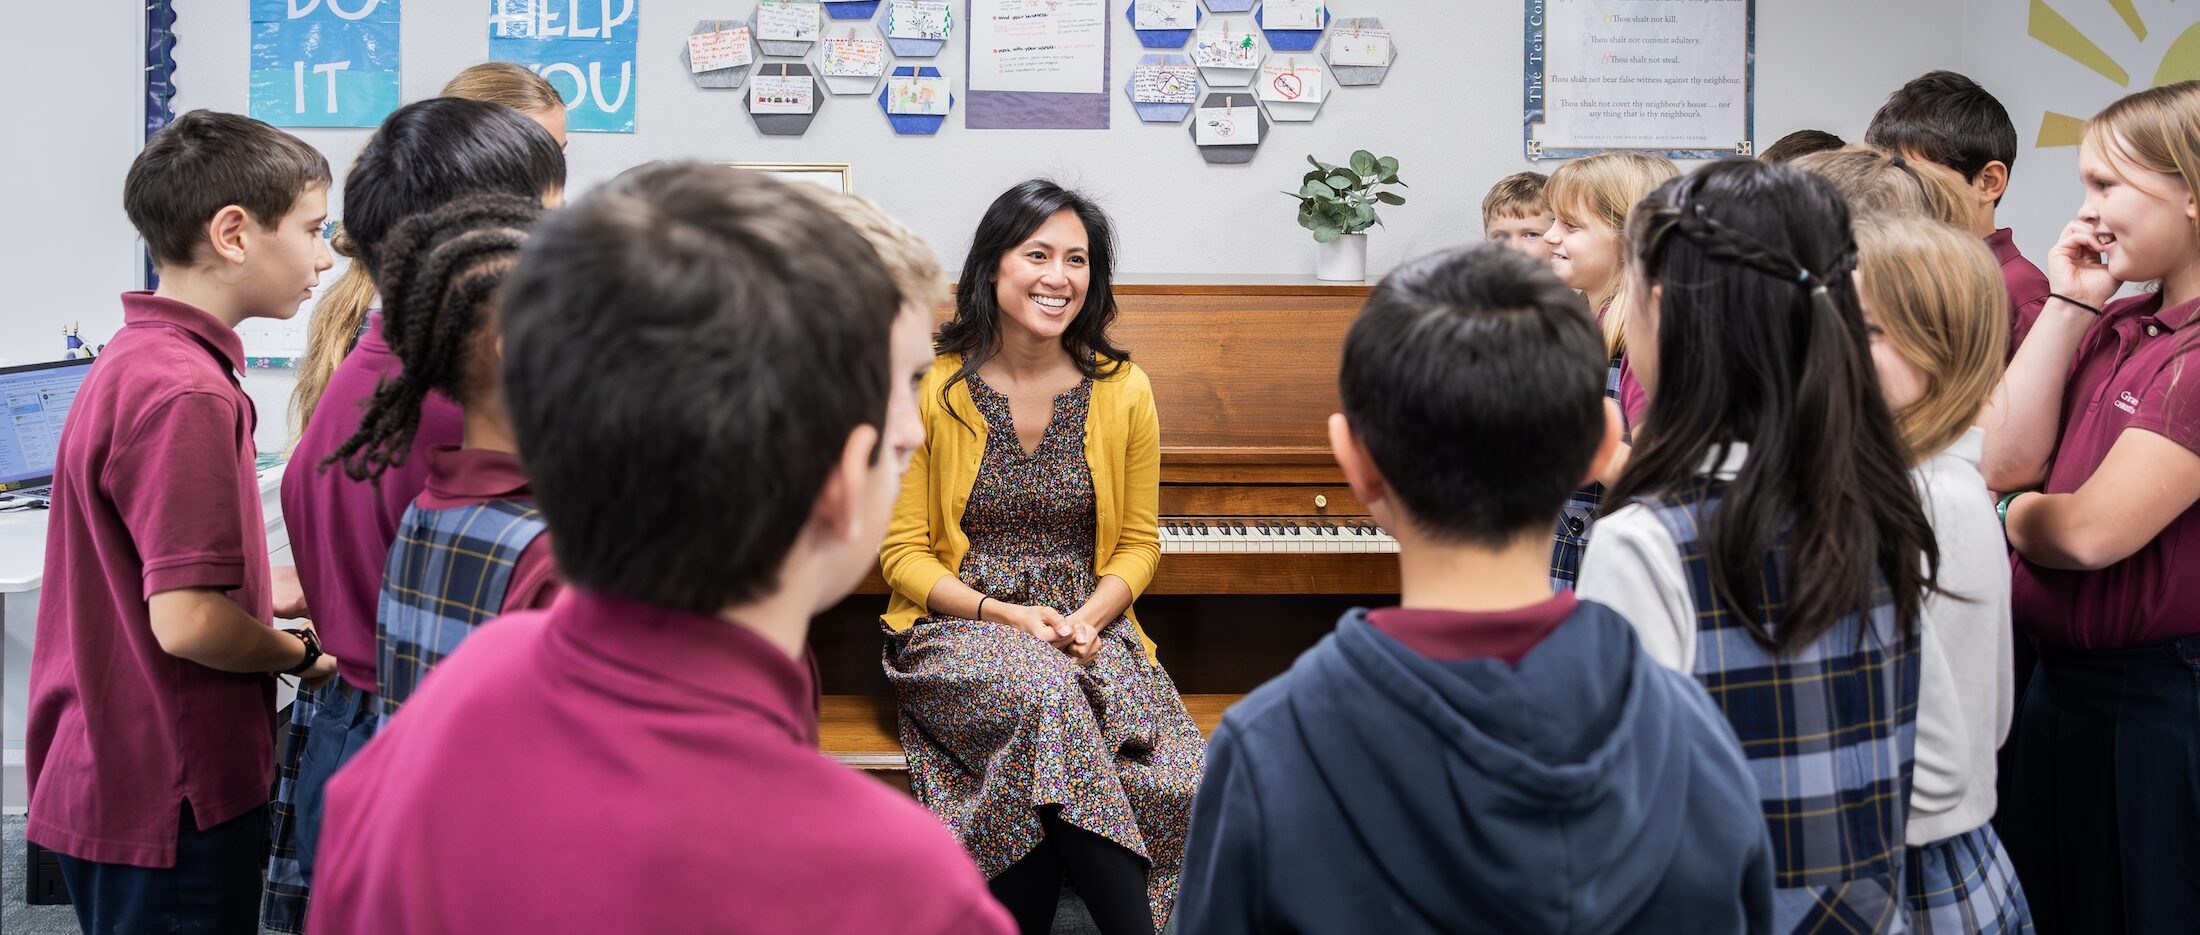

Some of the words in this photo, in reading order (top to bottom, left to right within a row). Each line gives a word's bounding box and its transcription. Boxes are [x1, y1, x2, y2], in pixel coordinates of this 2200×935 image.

[490, 0, 634, 38] HELP
[1612, 15, 1630, 23] Thou
[1632, 15, 1649, 23] shalt
[1664, 15, 1678, 23] kill.
[1591, 35, 1608, 43] Thou
[1670, 36, 1701, 45] adultery.
[1529, 34, 1542, 65] Ten
[1610, 55, 1628, 63] Thou
[1570, 75, 1587, 83] shalt
[1602, 75, 1617, 83] bear
[1619, 75, 1635, 83] false
[1664, 77, 1688, 85] against
[1690, 76, 1702, 85] thy
[1703, 76, 1741, 85] neighbour.
[294, 61, 351, 114] IT
[529, 61, 631, 113] OU
[1529, 72, 1542, 103] The
[1559, 99, 1578, 107] Thou
[1580, 99, 1597, 107] shalt
[1632, 100, 1643, 109] thy
[1645, 100, 1685, 109] neighbour's
[1687, 100, 1707, 108] house
[1589, 111, 1601, 119] any
[1603, 110, 1622, 118] thing
[1647, 110, 1658, 119] thy
[1660, 110, 1702, 119] neighbour's.
